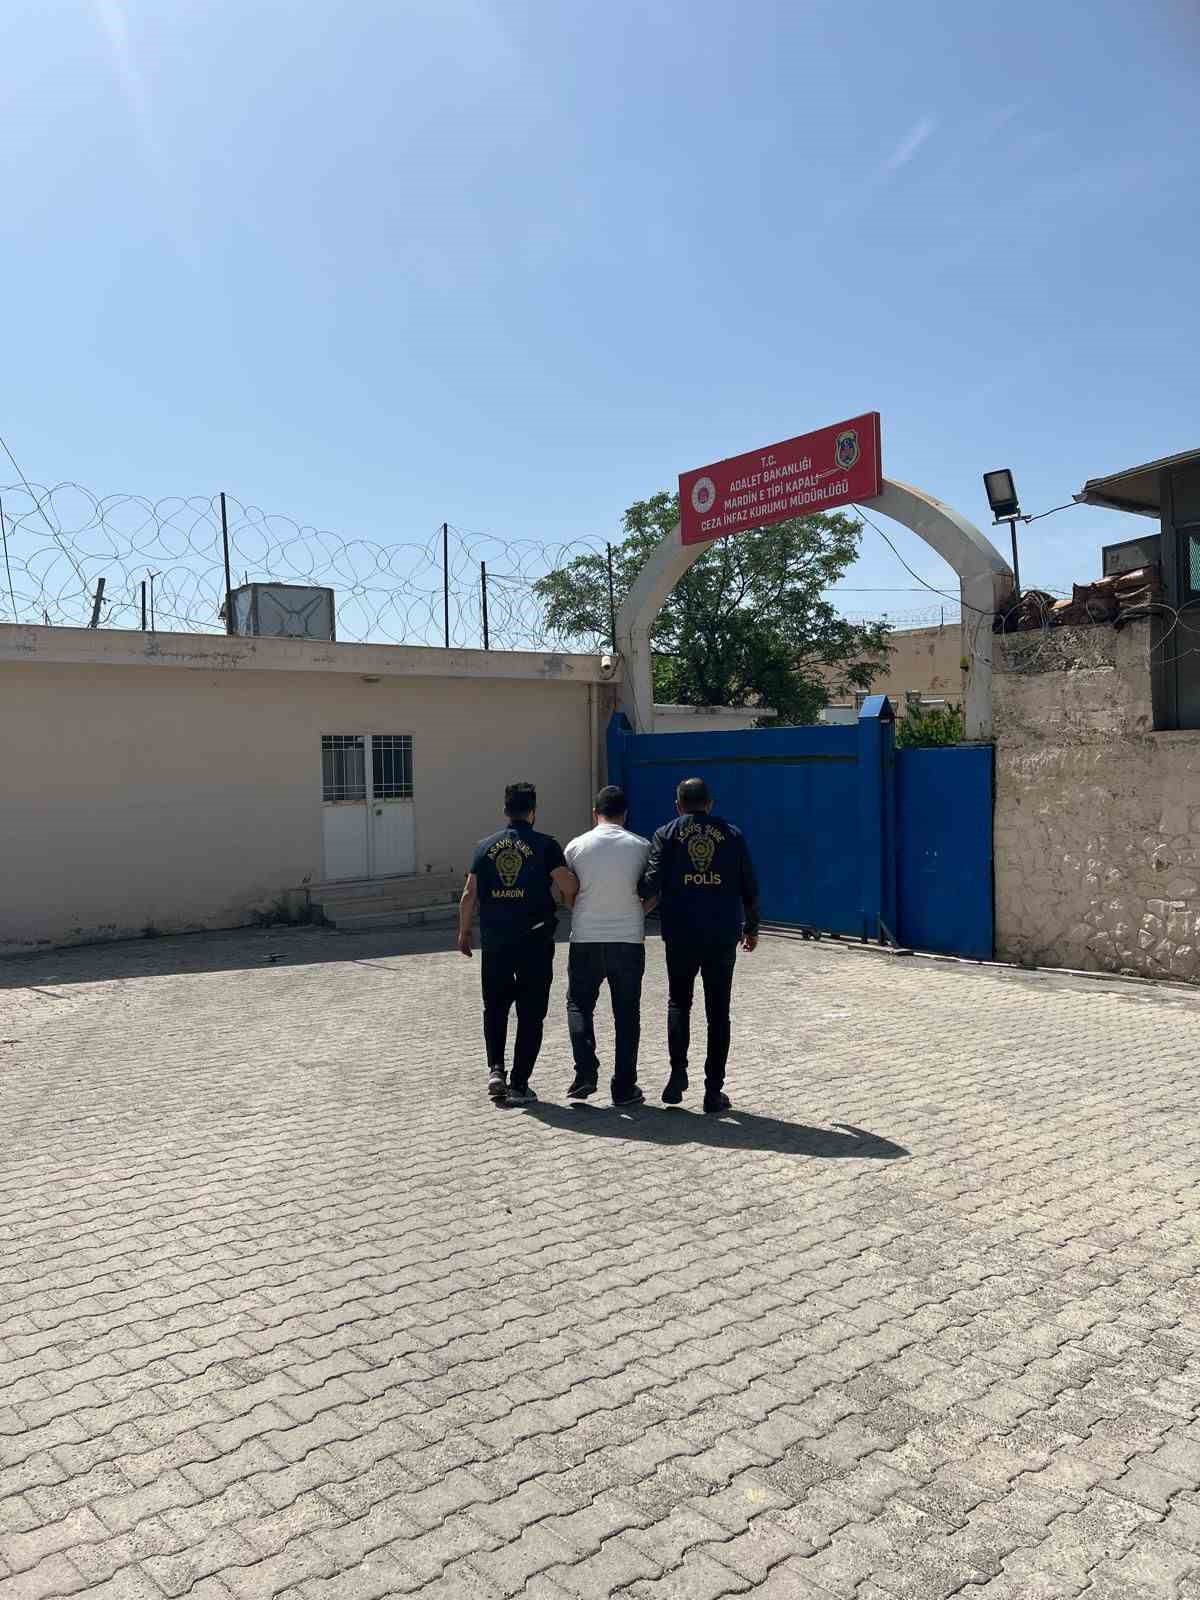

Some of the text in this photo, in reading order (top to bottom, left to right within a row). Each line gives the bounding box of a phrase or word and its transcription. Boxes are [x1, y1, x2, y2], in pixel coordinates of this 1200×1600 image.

[730, 457, 812, 492] ADALET BAKANLIĞI
[760, 455, 776, 468] T.C.
[702, 479, 849, 532] CEZA İNFAZ KURUMU MÜDÜRLÜĞÜ
[724, 475, 819, 511] MARDİN E TİPİ KAPALI
[684, 872, 721, 885] POLİS
